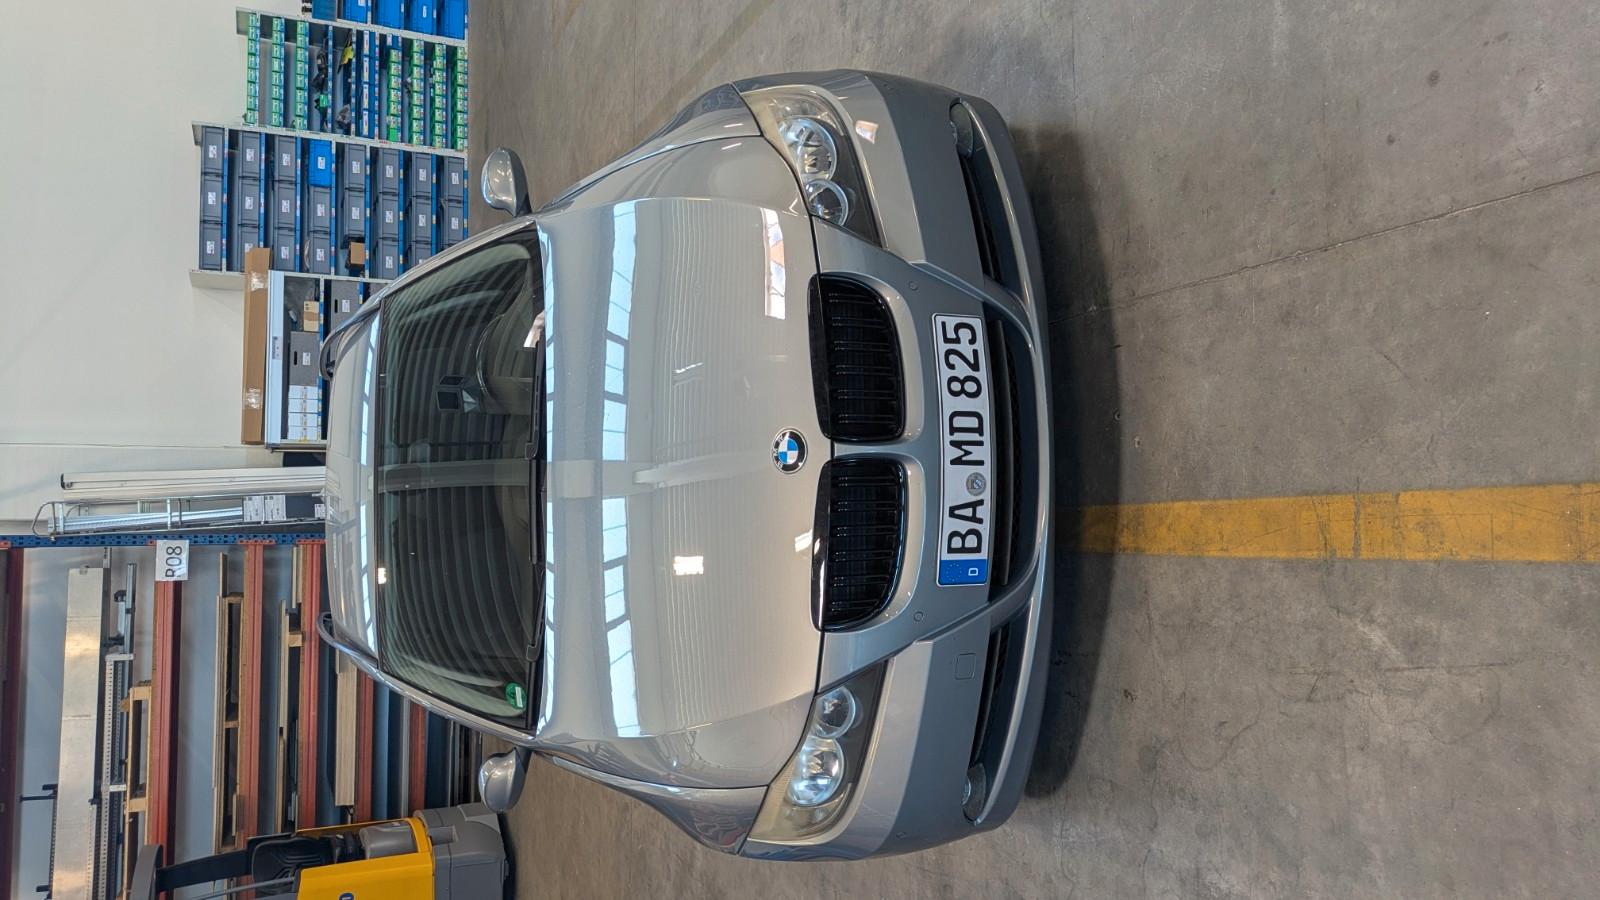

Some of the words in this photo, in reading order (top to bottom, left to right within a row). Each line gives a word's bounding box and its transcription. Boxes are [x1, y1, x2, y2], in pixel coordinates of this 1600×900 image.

[941, 321, 982, 399] 825
[949, 411, 985, 466] MD
[947, 498, 984, 554] BA
[165, 546, 183, 577] R08
[968, 567, 979, 577] D
